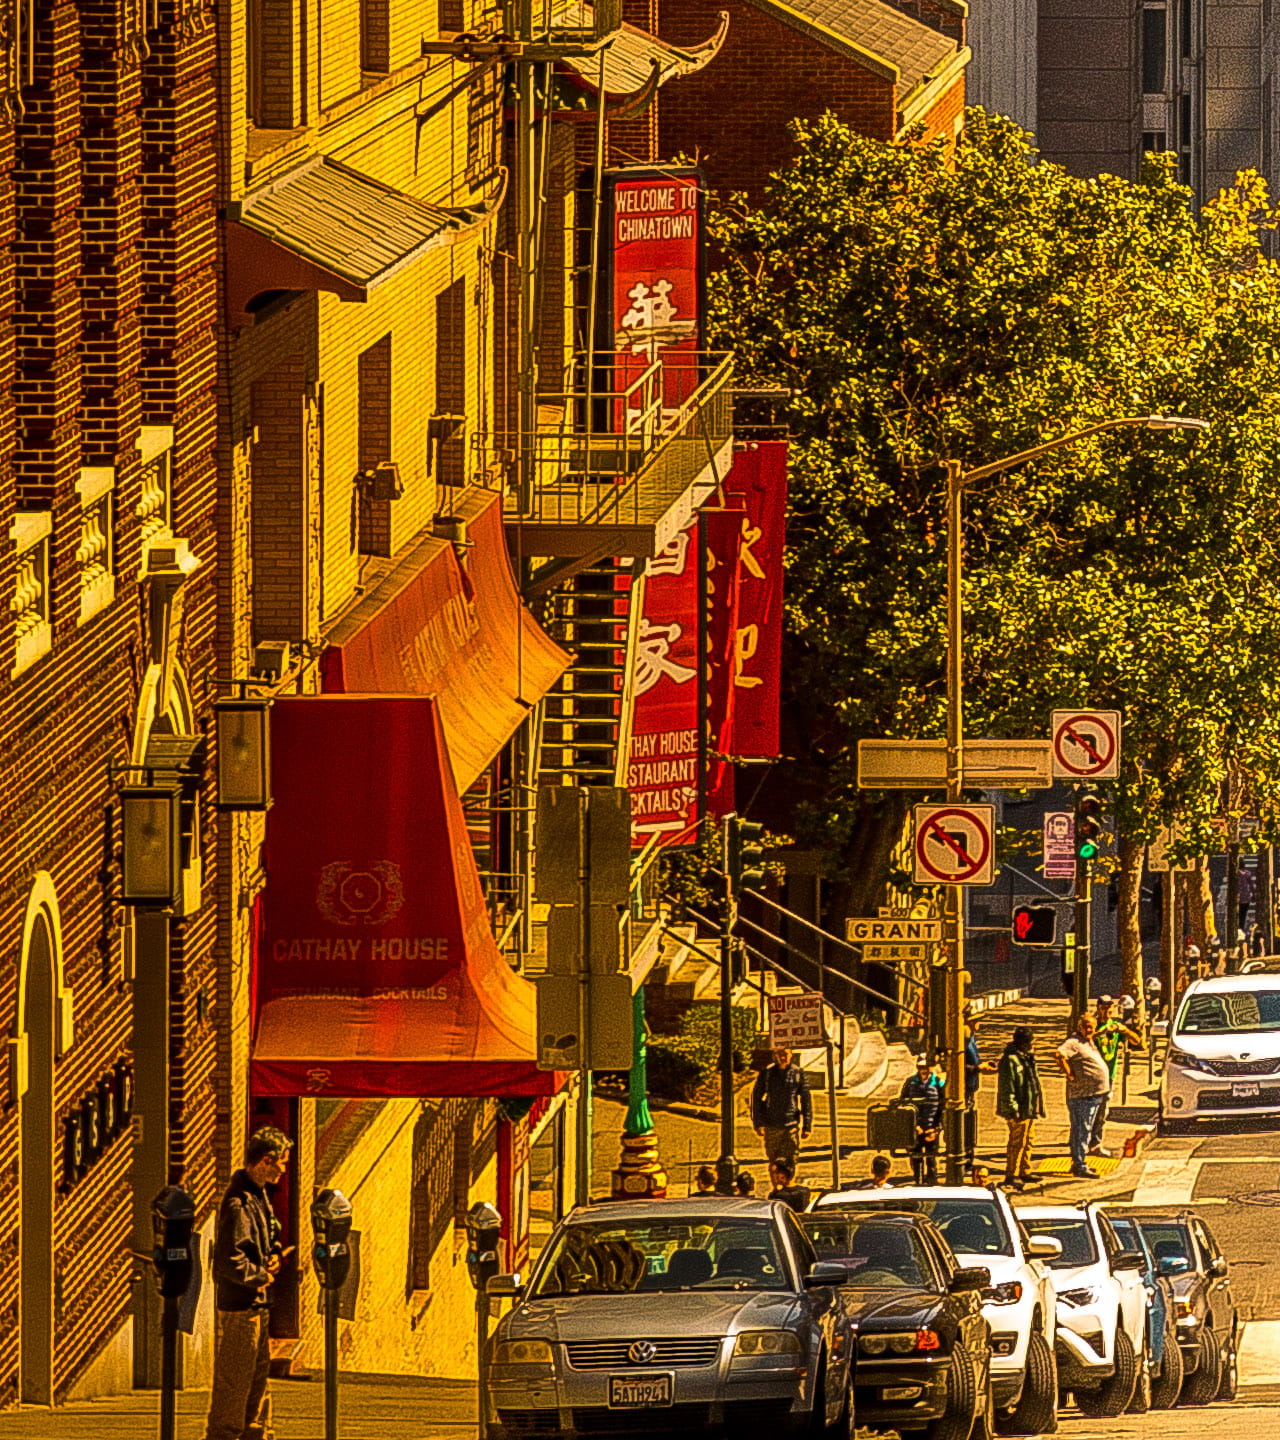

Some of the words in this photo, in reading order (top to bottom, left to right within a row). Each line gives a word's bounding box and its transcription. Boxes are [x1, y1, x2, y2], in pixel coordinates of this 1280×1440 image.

[615, 187, 676, 213] WELCOME
[680, 186, 697, 211] TO
[618, 215, 693, 242] CHINATOWN
[660, 730, 698, 756] HOUSE
[854, 923, 936, 939] GRANT
[272, 938, 362, 962] CATHAY
[371, 937, 449, 961] HOUSE
